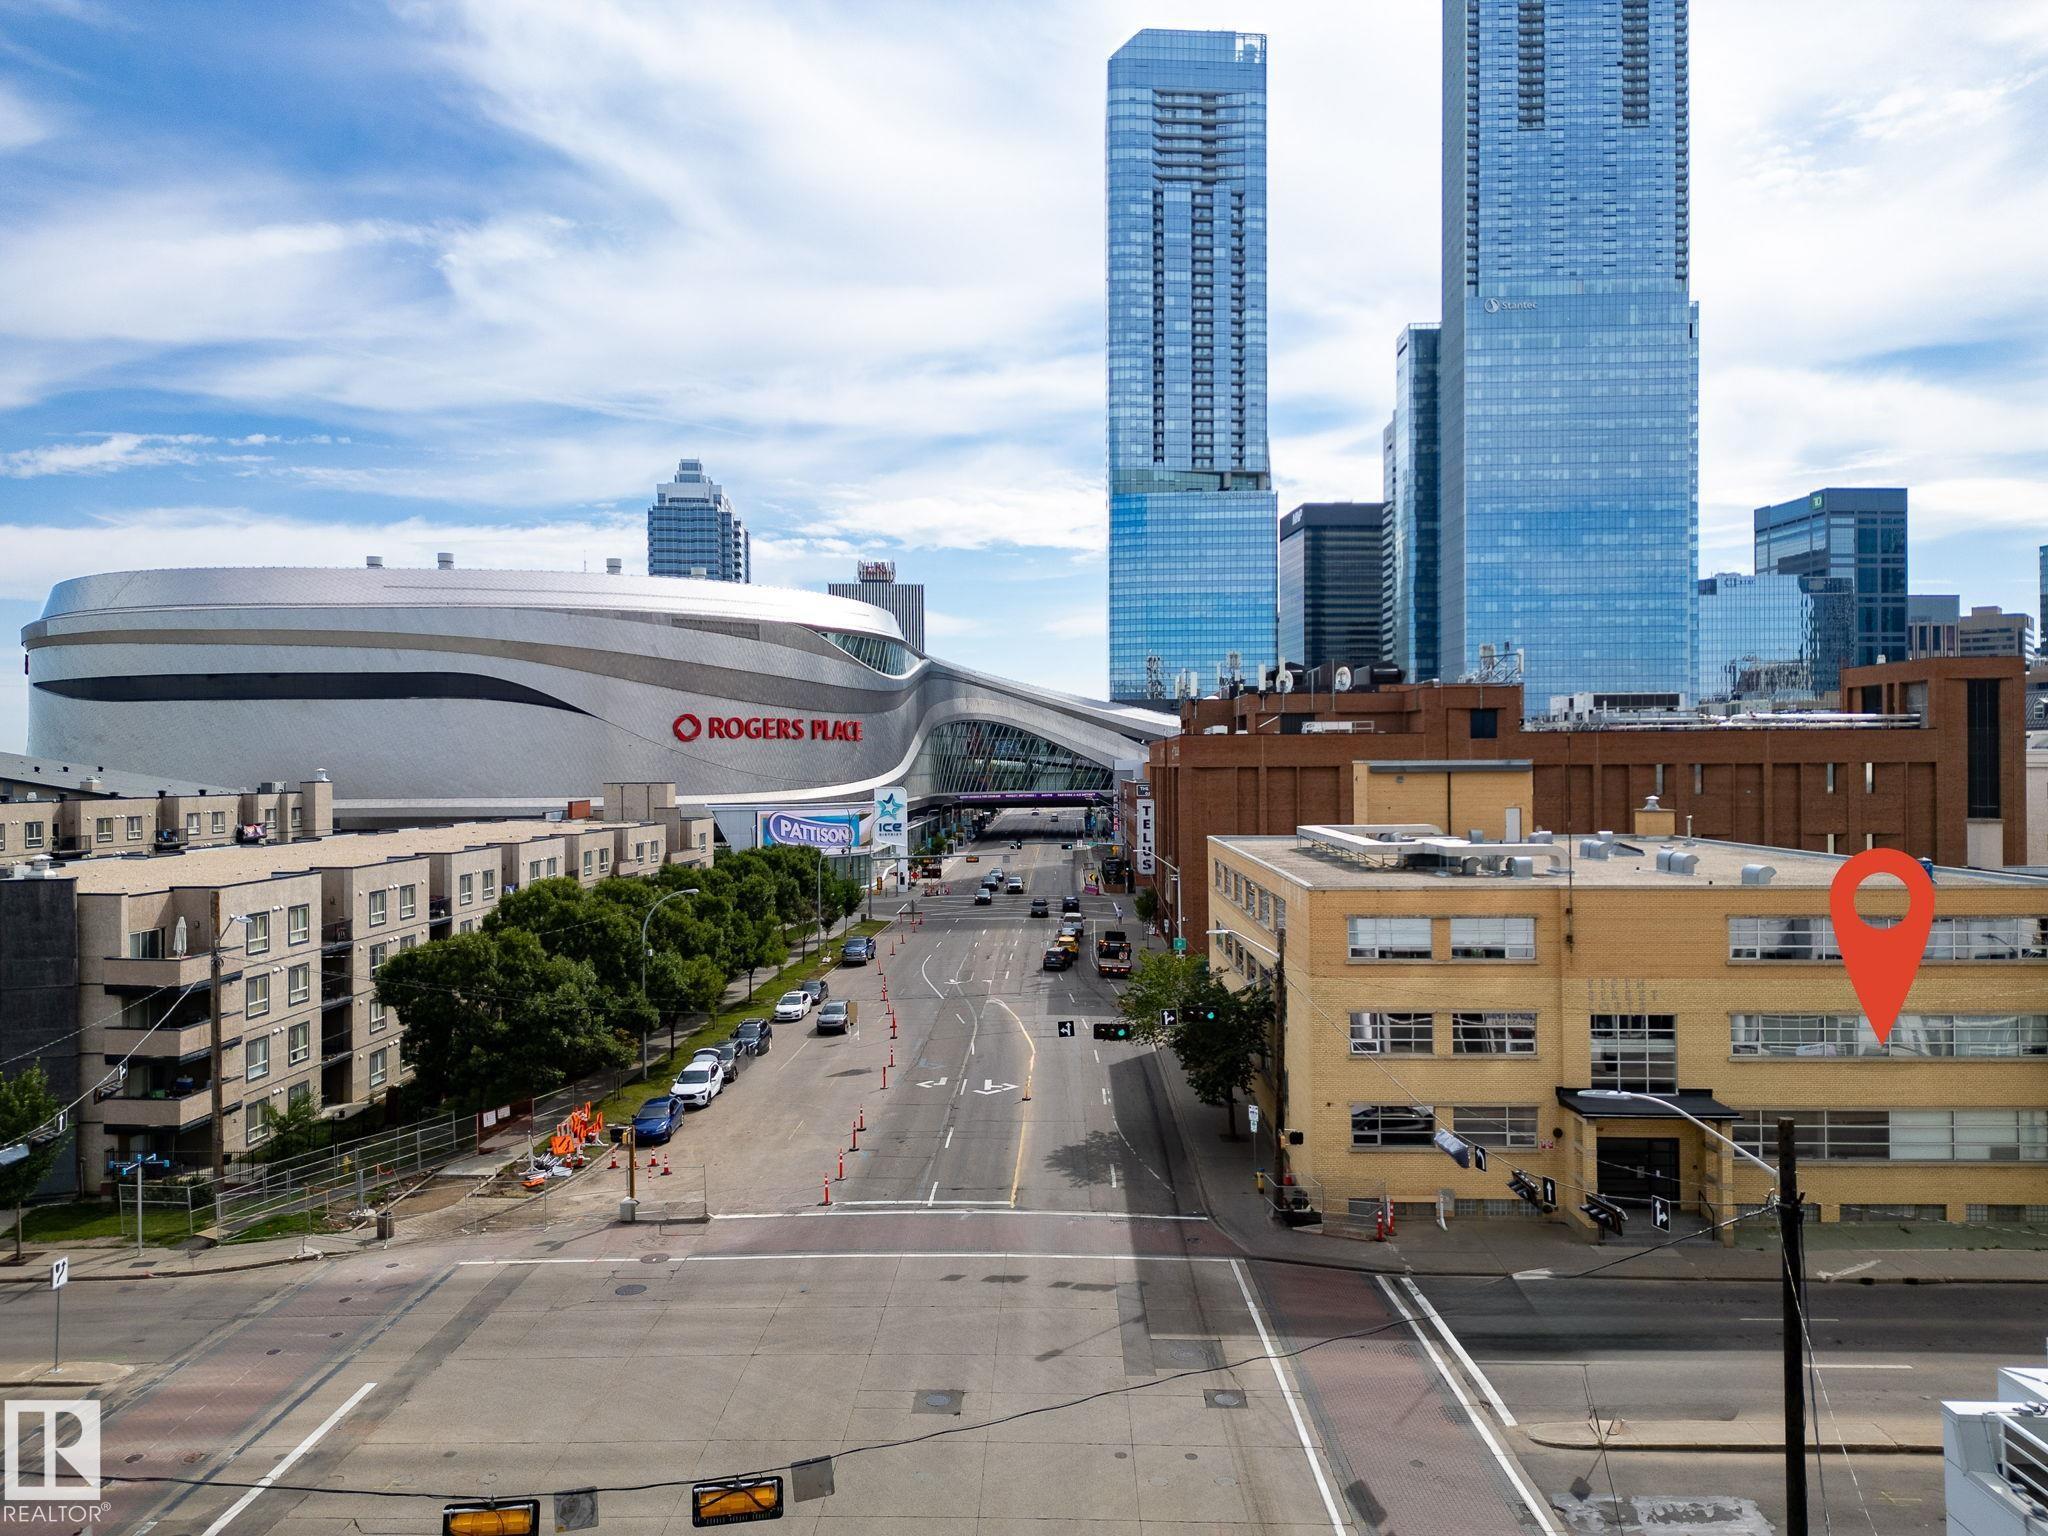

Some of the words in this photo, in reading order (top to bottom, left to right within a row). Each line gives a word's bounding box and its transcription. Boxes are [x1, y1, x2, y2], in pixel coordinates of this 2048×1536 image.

[1502, 302, 1537, 310] Stantec
[708, 717, 804, 740] ROGERS
[811, 719, 863, 742] PLACE
[780, 819, 849, 844] PATTISON
[1142, 805, 1152, 871] TELUS
